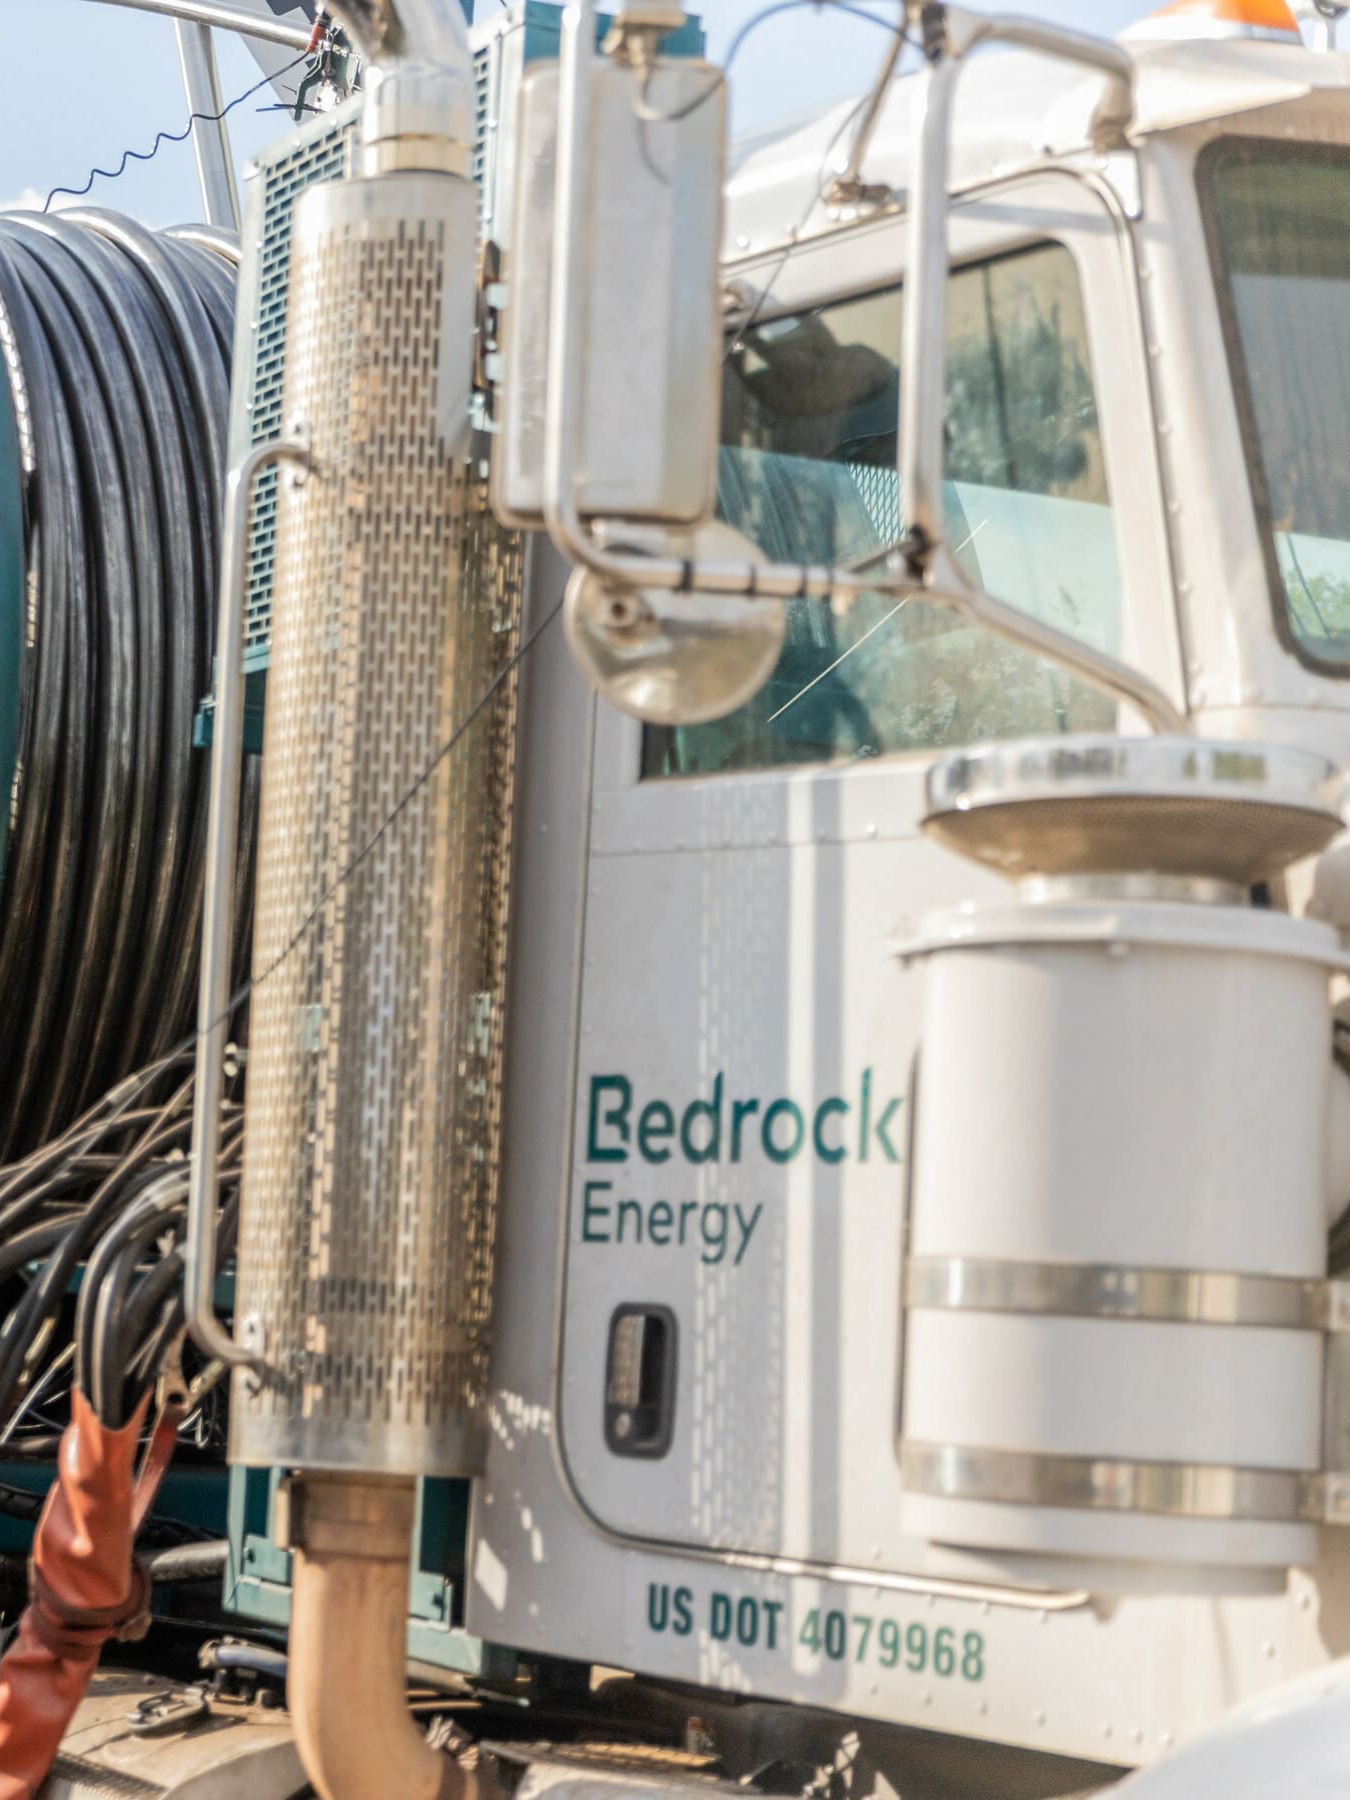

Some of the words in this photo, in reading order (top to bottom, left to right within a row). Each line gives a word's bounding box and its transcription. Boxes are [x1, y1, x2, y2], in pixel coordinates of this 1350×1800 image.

[586, 1067, 904, 1164] Bedrock
[582, 1181, 763, 1265] Energy
[648, 1583, 694, 1637] US
[710, 1592, 784, 1650] DOT
[798, 1608, 985, 1682] 4079968
